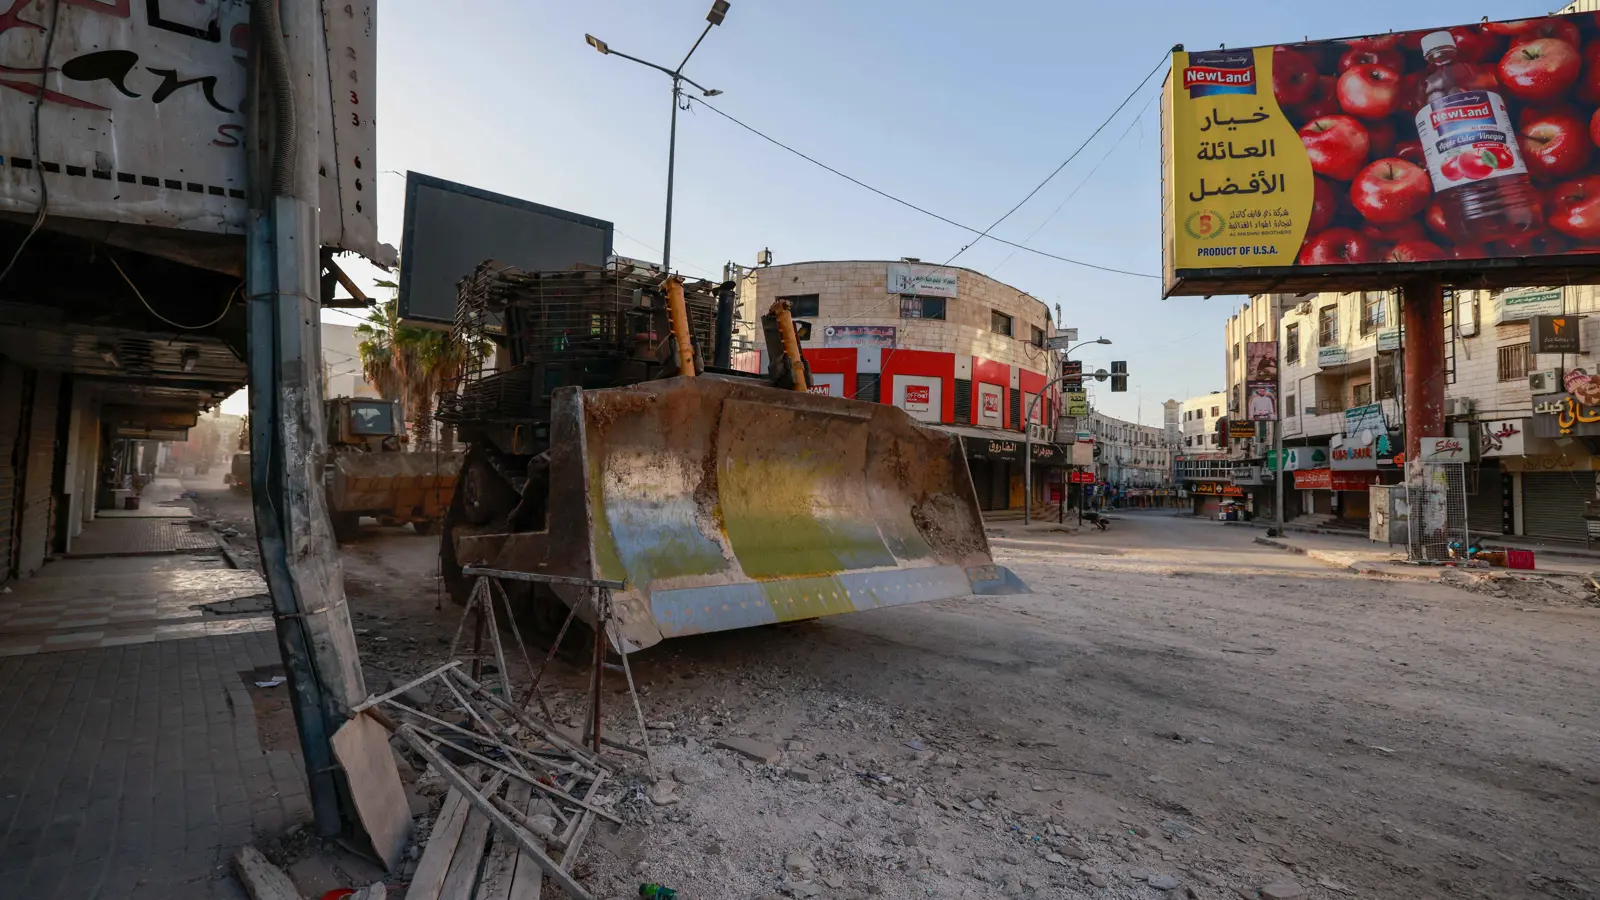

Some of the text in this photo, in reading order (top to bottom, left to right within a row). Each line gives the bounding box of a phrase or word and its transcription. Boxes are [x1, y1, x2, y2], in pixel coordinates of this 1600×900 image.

[1186, 70, 1251, 83] NewLand
[1200, 106, 1270, 132] خيار
[1432, 105, 1490, 124] NewLand
[1197, 139, 1275, 161] العائلة
[1189, 170, 1285, 202] الأفضل
[1273, 206, 1289, 217] شركة
[1199, 215, 1213, 235] 5
[1197, 245, 1279, 257] PRODUCT OF U.S.A.
[1535, 399, 1565, 415] كيك
[988, 439, 1017, 453] الفاروق
[1435, 439, 1459, 458] Sky
